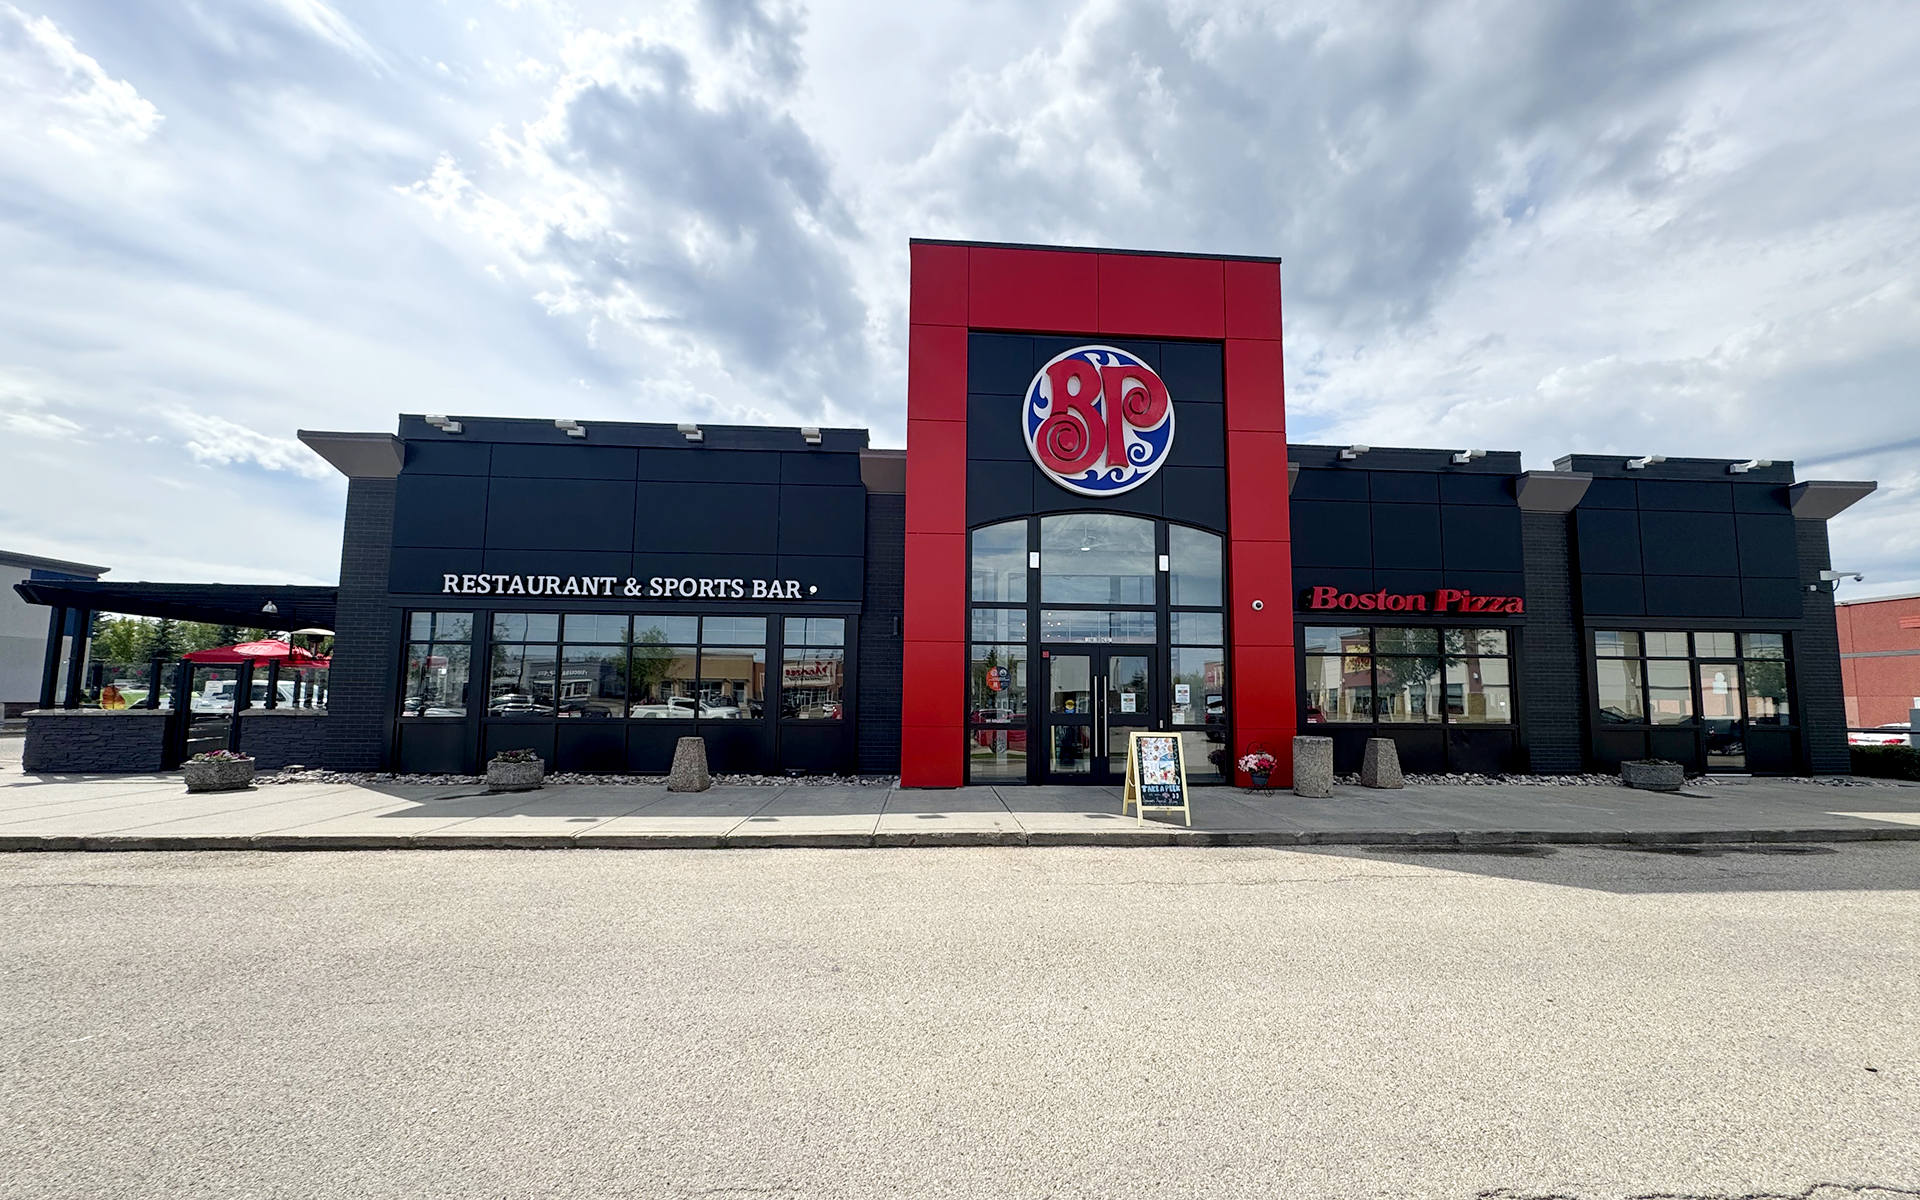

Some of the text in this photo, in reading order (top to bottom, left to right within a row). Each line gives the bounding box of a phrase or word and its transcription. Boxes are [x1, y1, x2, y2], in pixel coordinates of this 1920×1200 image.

[1036, 359, 1168, 475] BP
[442, 573, 802, 599] RESTAURANT & SPORTS BAR
[1309, 585, 1525, 613] Boston Pizza
